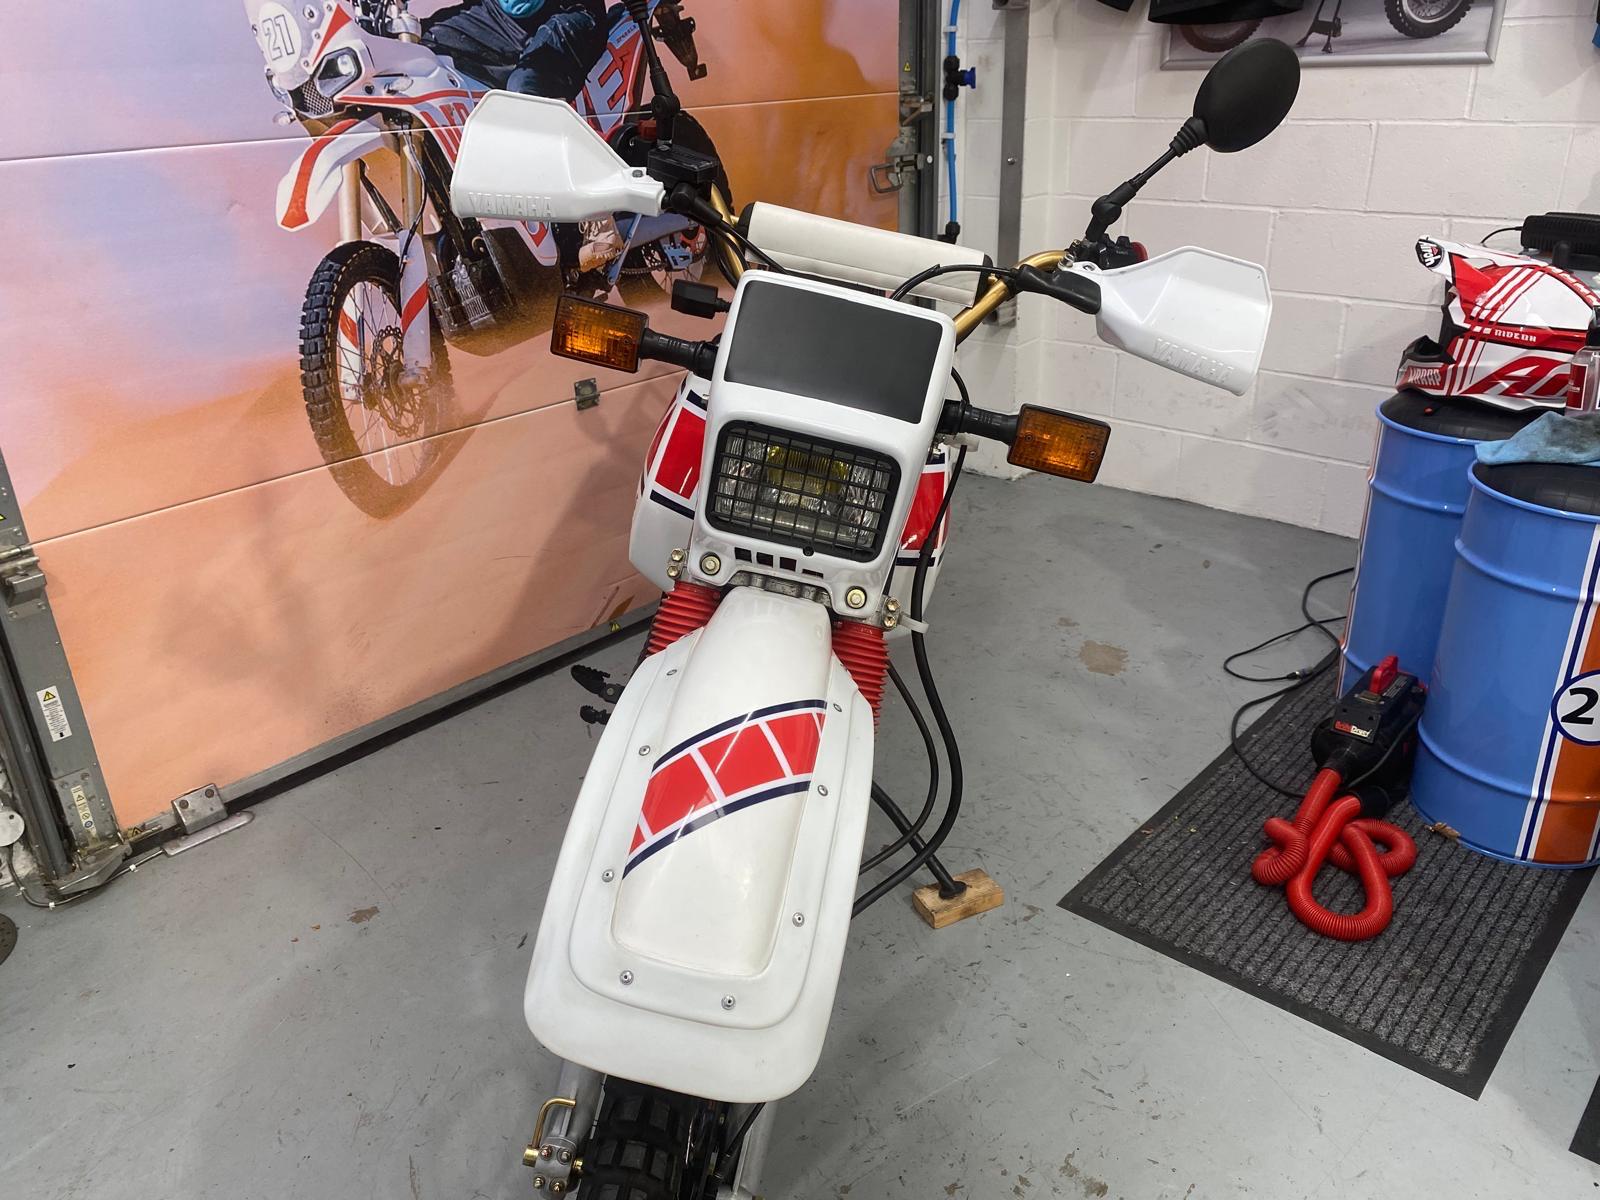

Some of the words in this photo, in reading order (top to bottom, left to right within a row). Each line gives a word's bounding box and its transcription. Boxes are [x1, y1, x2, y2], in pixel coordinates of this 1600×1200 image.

[261, 14, 296, 61] 21
[467, 191, 553, 218] YAMAHA
[1151, 338, 1236, 384] YAMAHA
